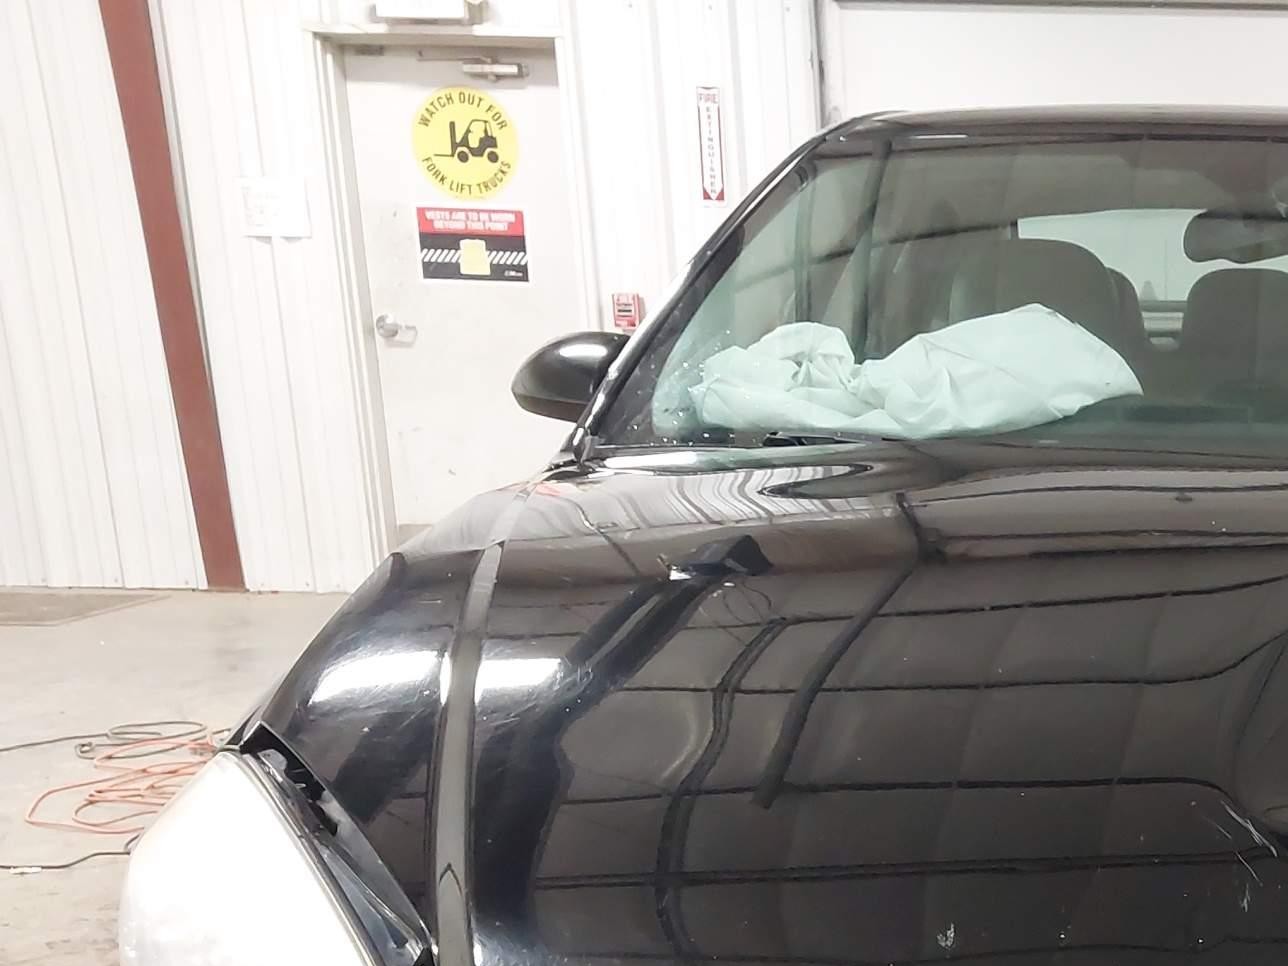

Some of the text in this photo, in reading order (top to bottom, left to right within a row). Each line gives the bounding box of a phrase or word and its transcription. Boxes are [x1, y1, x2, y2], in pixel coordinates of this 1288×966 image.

[418, 91, 508, 130] WATCH OUT FOR
[698, 92, 718, 104] FIRE
[422, 156, 511, 196] FORK LIFT TRUCKS
[468, 212, 478, 221] TO
